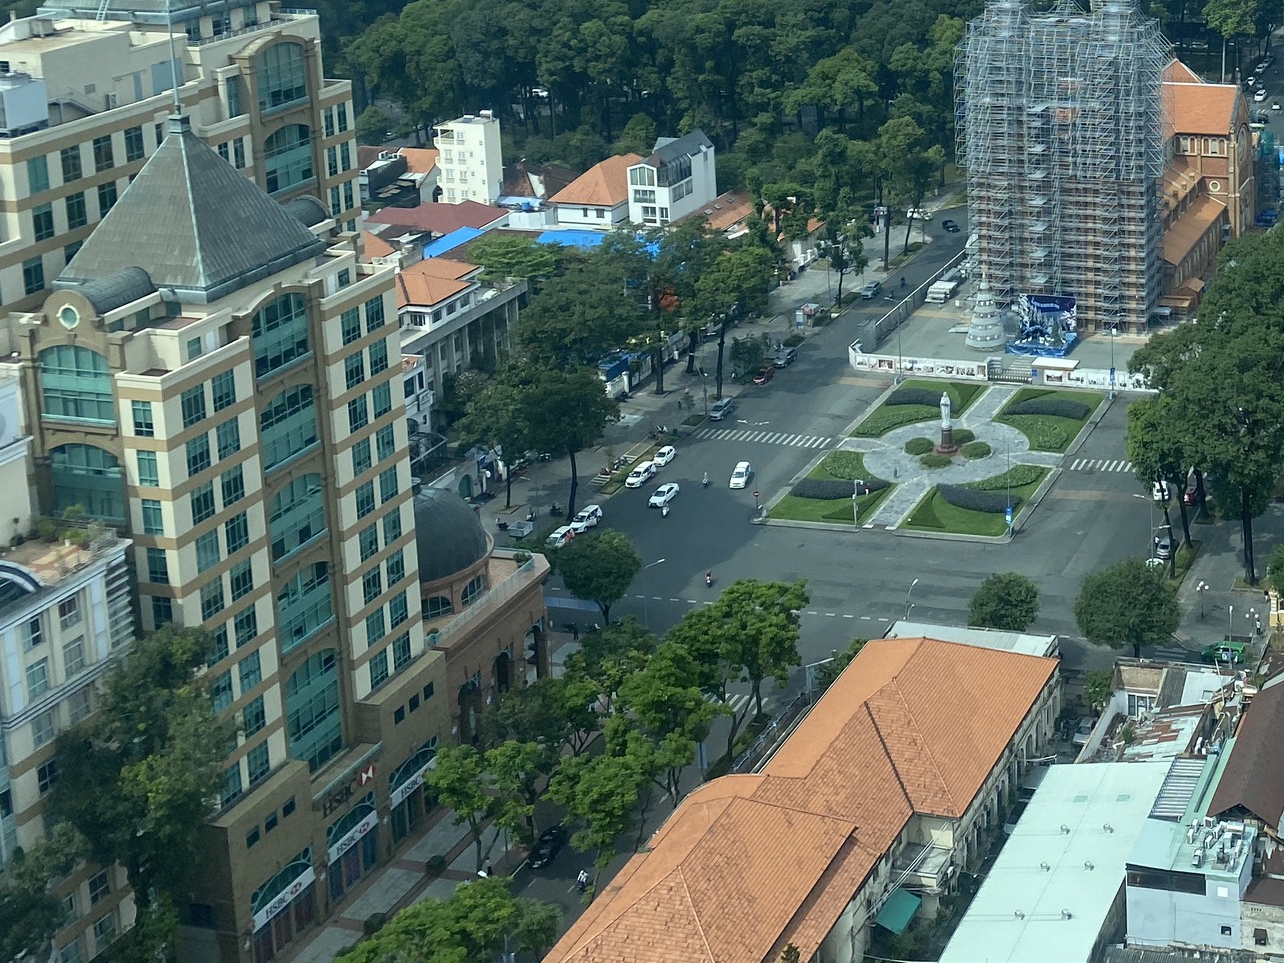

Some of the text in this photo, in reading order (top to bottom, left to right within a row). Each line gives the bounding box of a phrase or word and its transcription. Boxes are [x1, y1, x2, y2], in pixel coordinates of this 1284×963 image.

[323, 781, 357, 818] HSBC
[401, 776, 421, 798] HSBC
[336, 829, 359, 856] HSBC
[265, 891, 290, 919] HSBC
